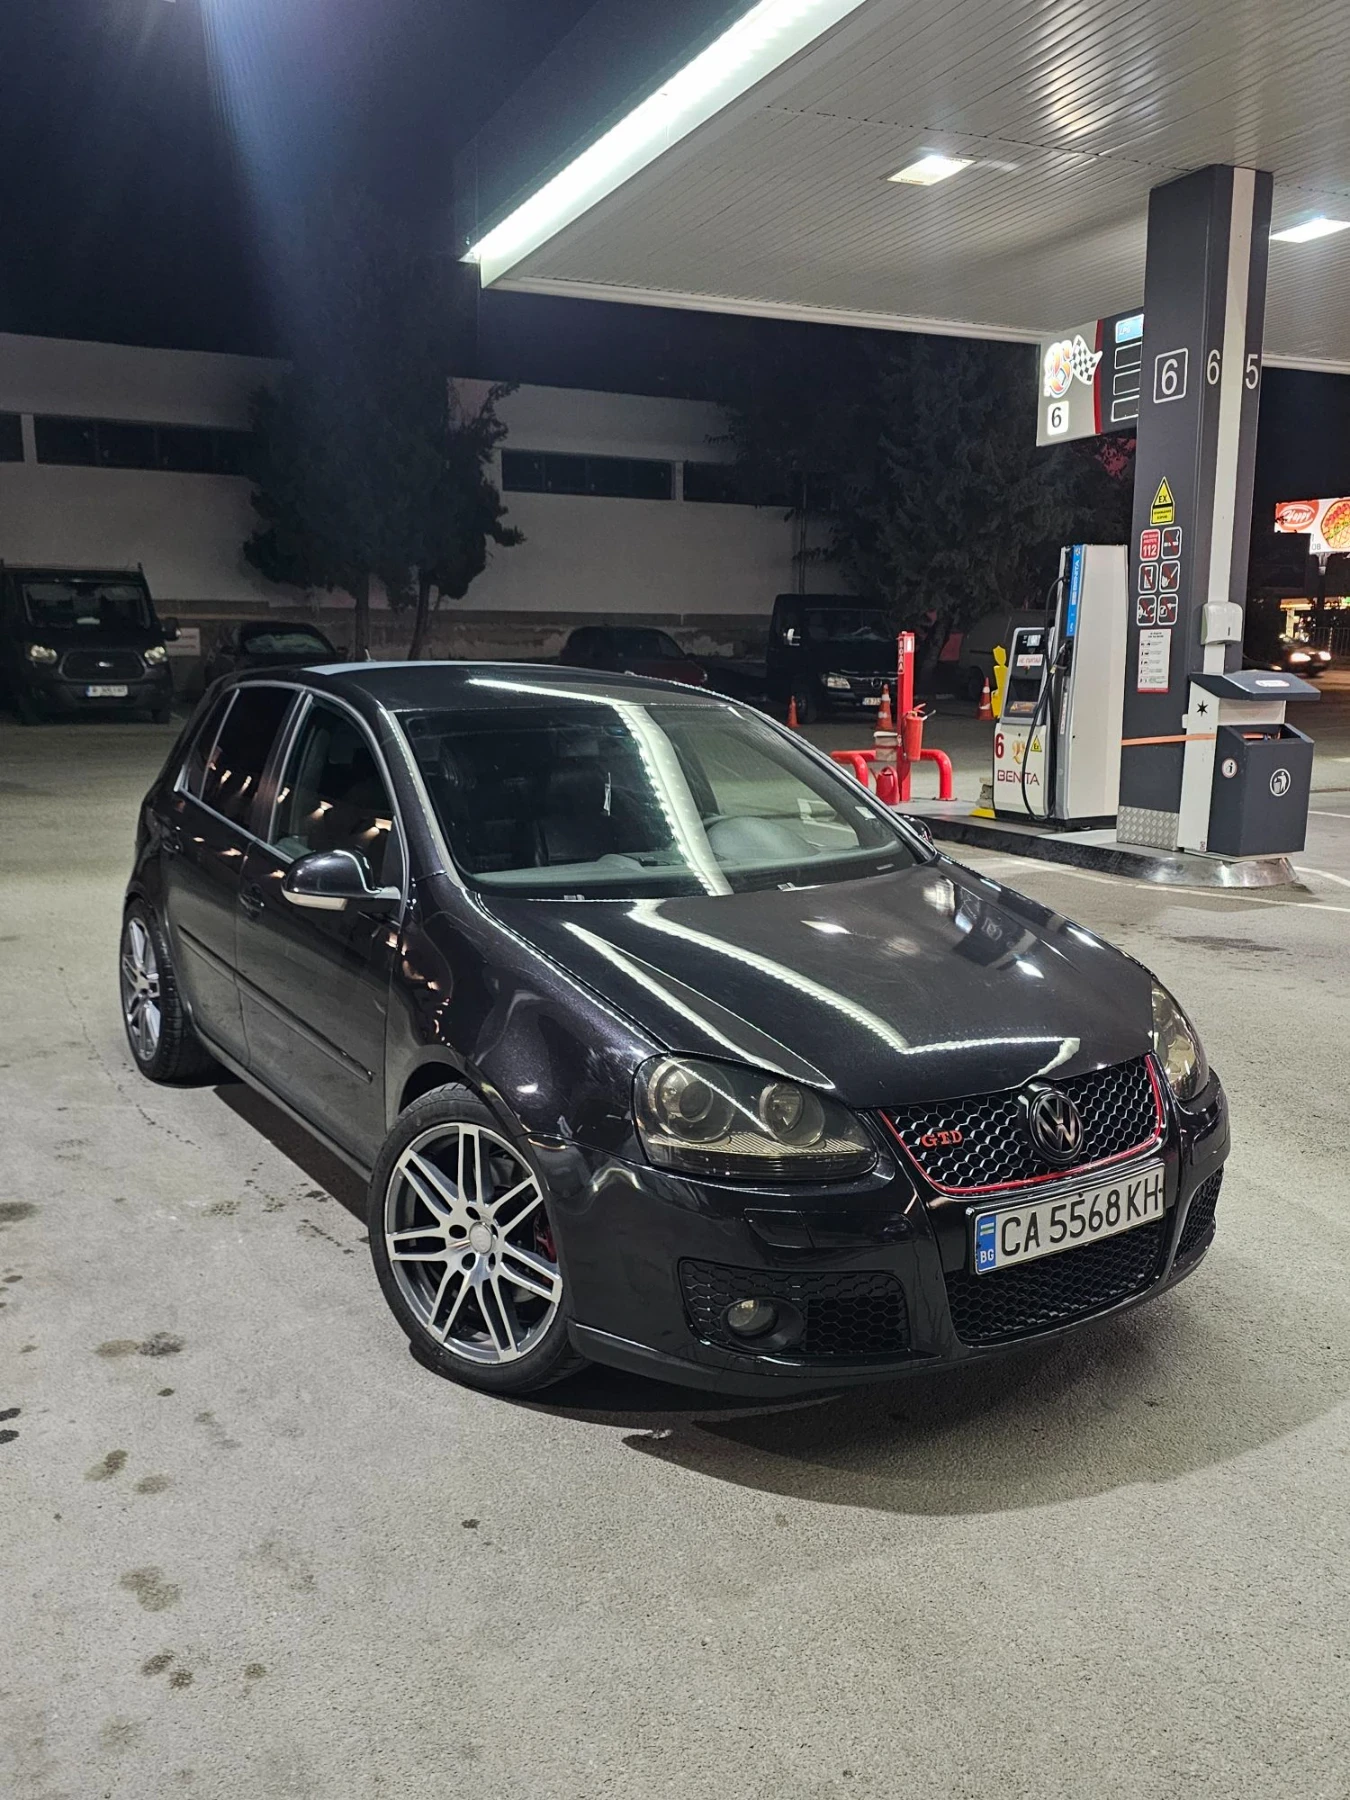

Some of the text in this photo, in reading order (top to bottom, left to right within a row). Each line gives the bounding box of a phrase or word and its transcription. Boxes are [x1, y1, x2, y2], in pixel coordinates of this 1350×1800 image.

[1161, 358, 1178, 395] 6
[1206, 349, 1221, 385] 6
[1244, 353, 1259, 390] 5
[1051, 406, 1062, 428] 6
[1158, 494, 1168, 503] EX
[1143, 543, 1157, 557] 112
[995, 733, 1005, 759] 6
[997, 769, 1040, 786] BENTA
[920, 1130, 963, 1148] GTD
[980, 1173, 1160, 1264] BG CA 5568 KH
